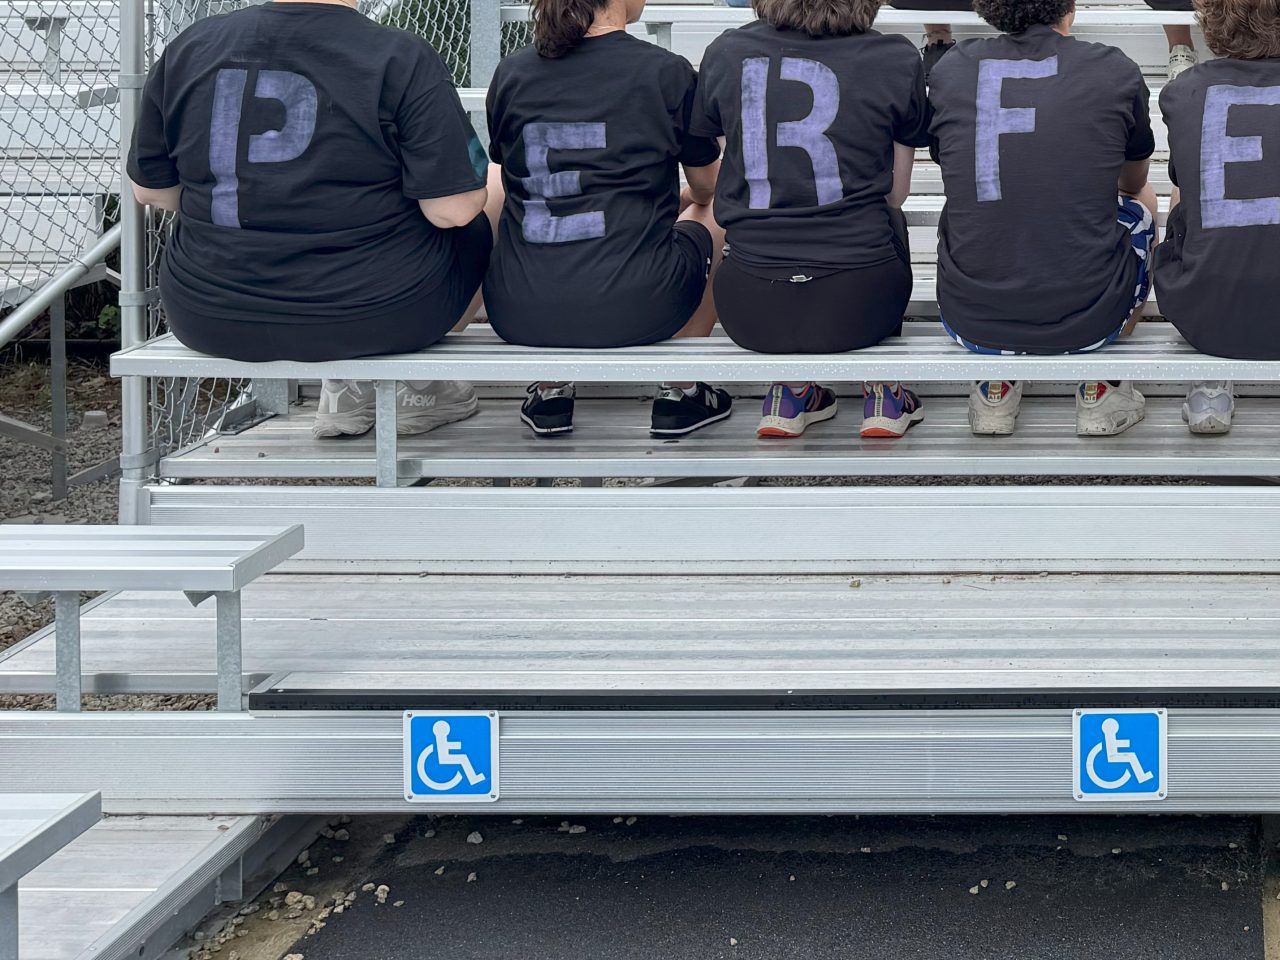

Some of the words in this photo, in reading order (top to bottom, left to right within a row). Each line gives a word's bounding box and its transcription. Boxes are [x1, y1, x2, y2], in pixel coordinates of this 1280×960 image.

[208, 68, 318, 229] P
[522, 122, 607, 244] E
[740, 56, 844, 209] R
[975, 56, 1059, 202] F
[401, 393, 437, 407] HOKA
